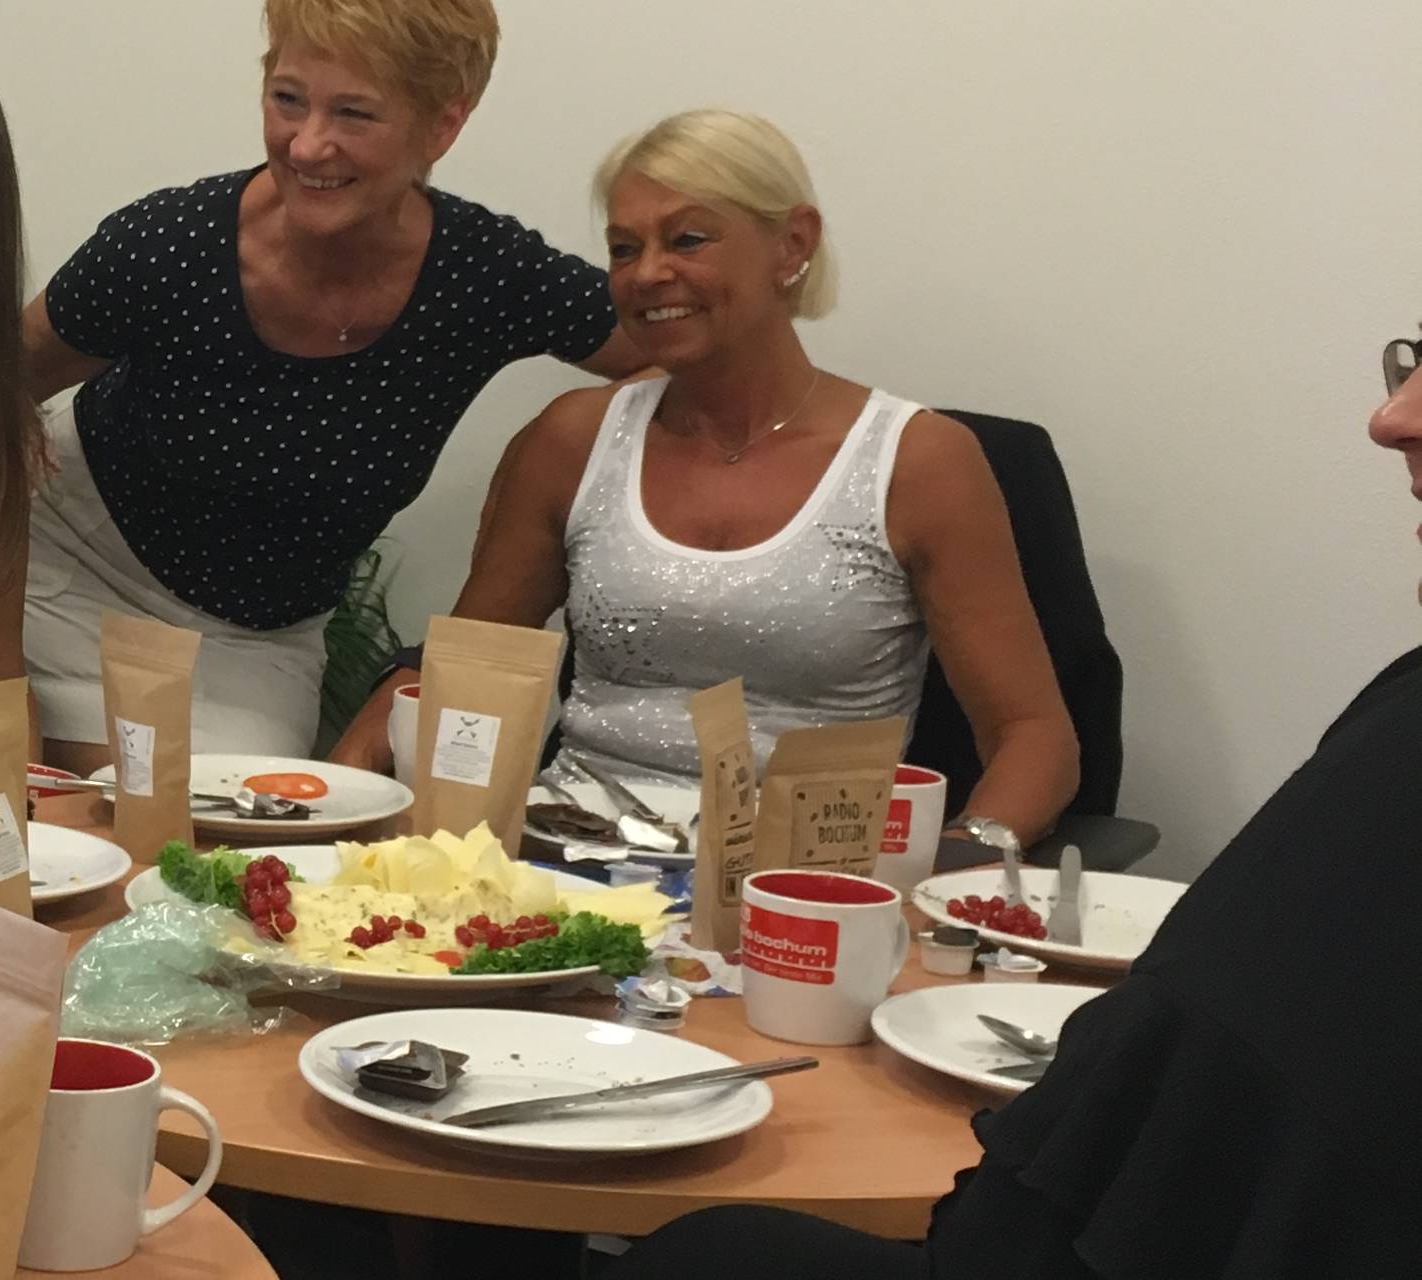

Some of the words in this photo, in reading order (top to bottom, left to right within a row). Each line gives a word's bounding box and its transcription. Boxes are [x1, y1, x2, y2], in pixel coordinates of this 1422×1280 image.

[823, 803, 860, 820] RADIO
[818, 824, 867, 844] BOCHUM
[754, 931, 826, 956] bochum
